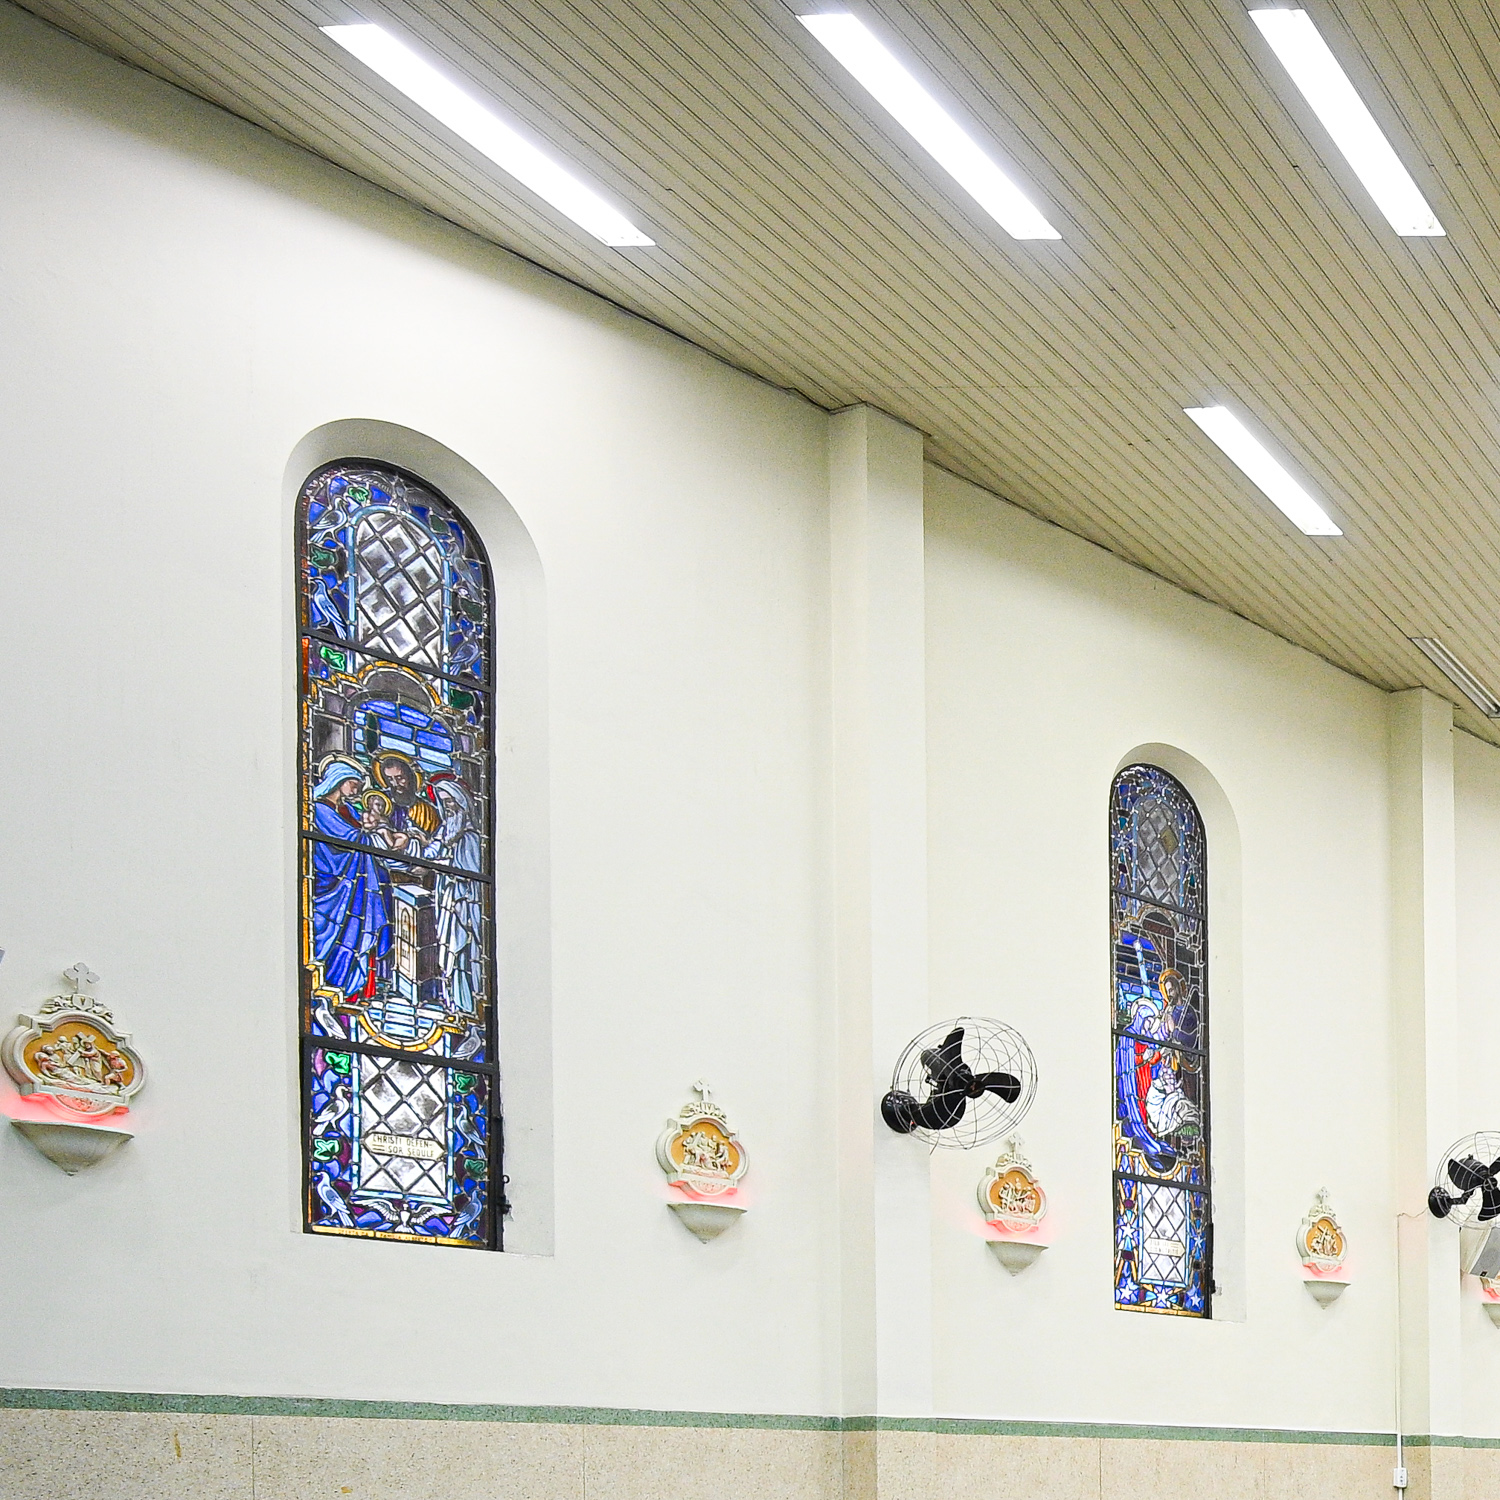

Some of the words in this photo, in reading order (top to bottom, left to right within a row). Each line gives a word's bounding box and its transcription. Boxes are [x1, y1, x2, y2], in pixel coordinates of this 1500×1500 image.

[80, 996, 86, 1005] V
[373, 1135, 402, 1145] CHRISTI
[388, 1145, 403, 1155] SOR
